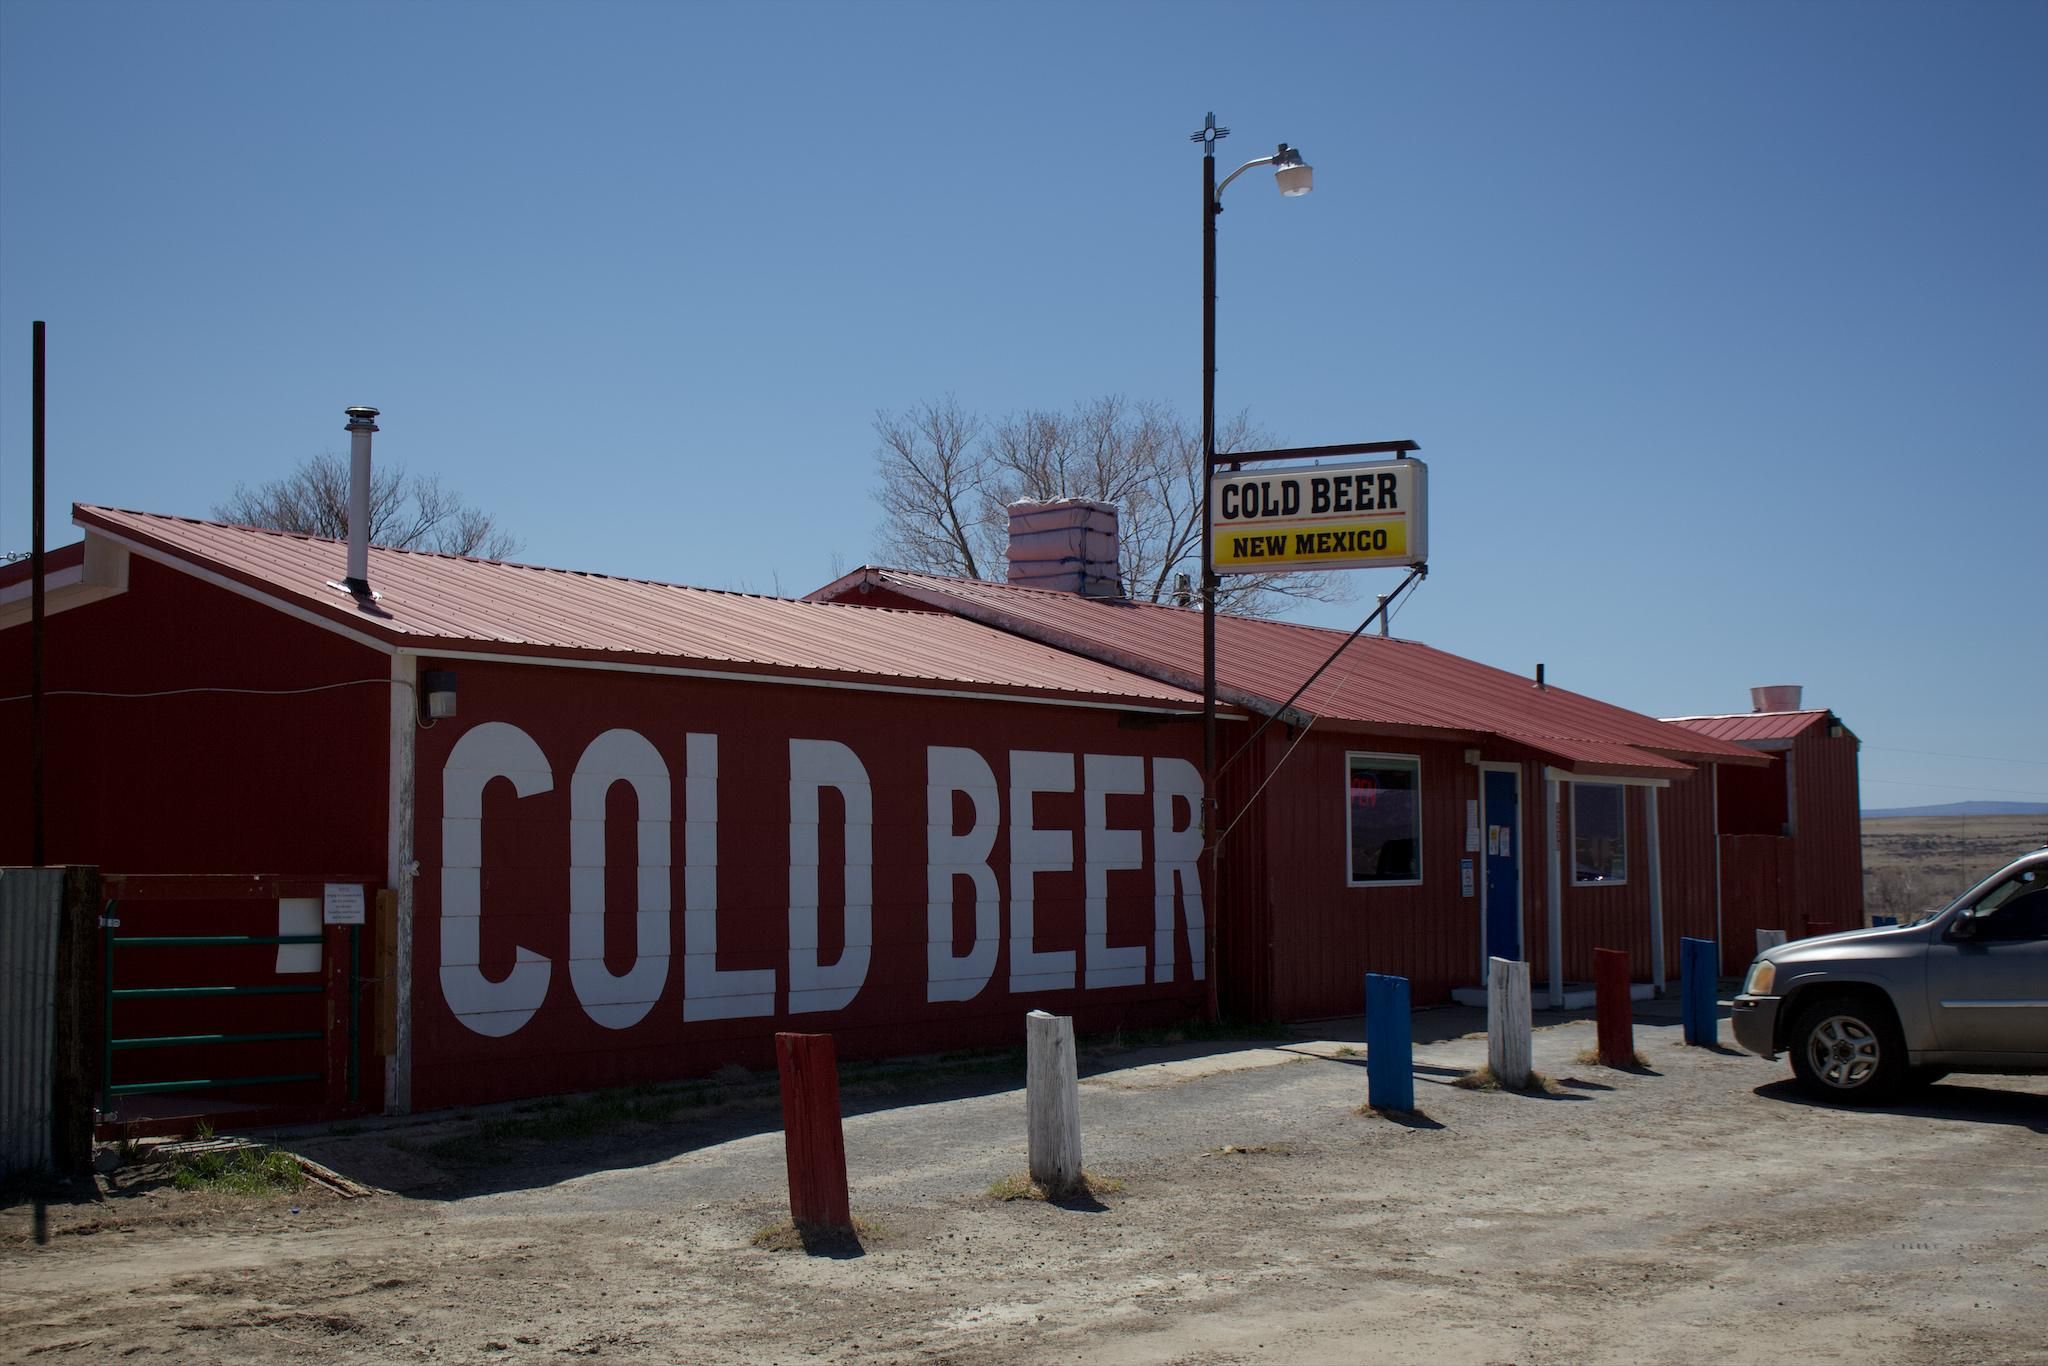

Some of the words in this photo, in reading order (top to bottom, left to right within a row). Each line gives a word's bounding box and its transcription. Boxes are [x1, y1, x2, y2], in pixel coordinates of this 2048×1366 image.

[1222, 480, 1300, 519] COLD
[1311, 473, 1397, 514] BEER
[1233, 535, 1287, 558] NEW
[1295, 529, 1387, 555] MEXICO
[439, 721, 873, 1038] COLD
[927, 745, 1205, 1003] BEER
